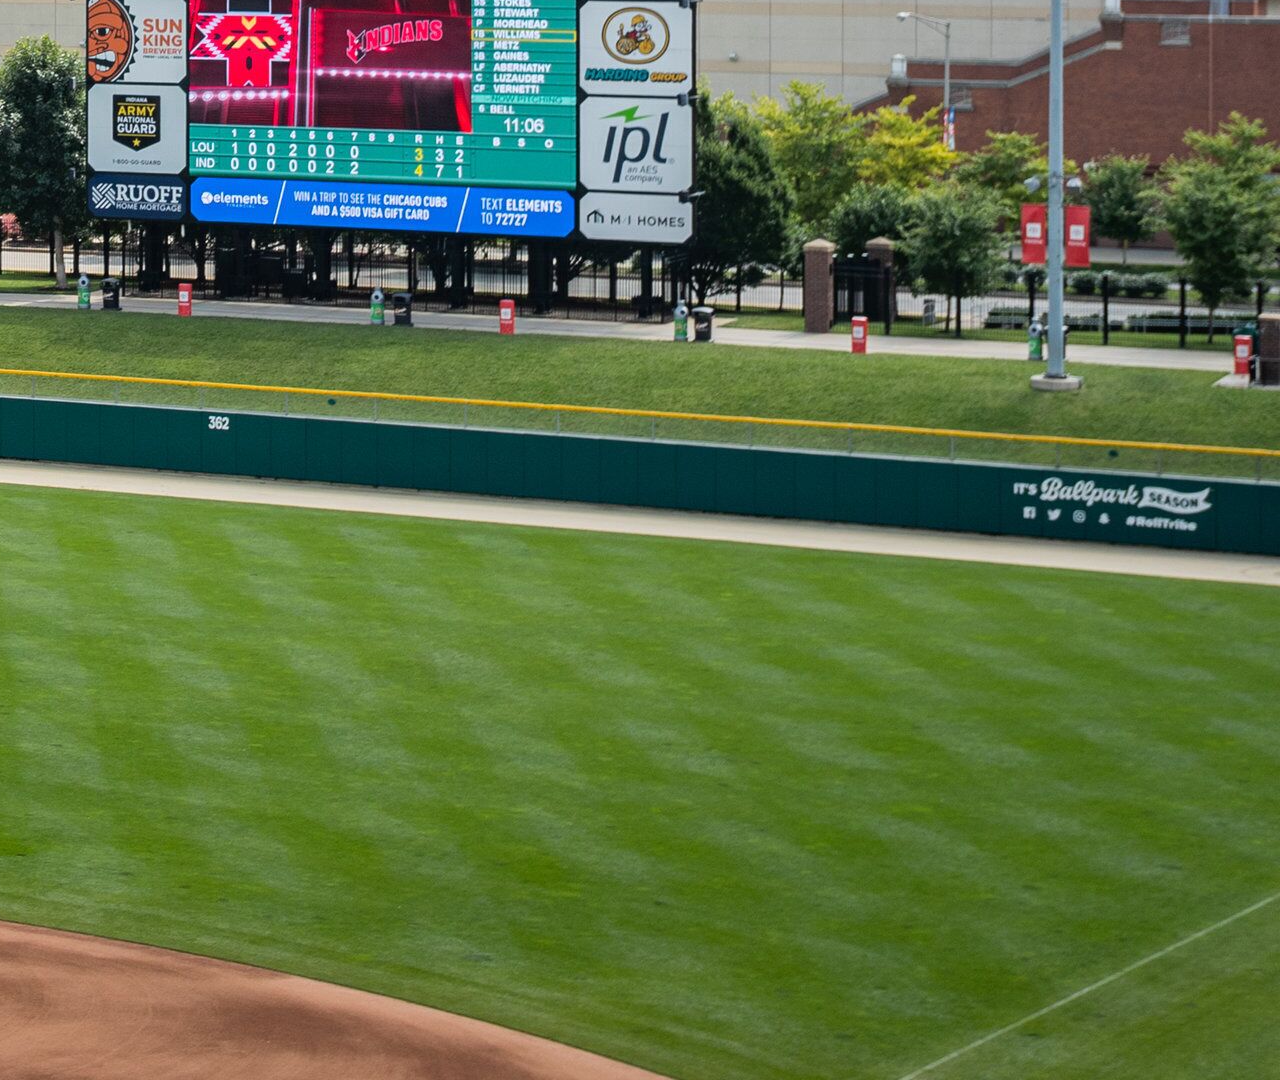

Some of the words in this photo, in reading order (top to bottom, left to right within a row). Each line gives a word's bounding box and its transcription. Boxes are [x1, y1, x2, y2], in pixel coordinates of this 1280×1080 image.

[493, 8, 540, 18] STEWART
[143, 18, 183, 33] SUN
[476, 18, 483, 27] P
[493, 18, 548, 29] MOREHEAD
[493, 29, 541, 39] WILLIAMS
[143, 34, 183, 47] KING
[473, 41, 486, 50] RF
[493, 41, 520, 50] METZ
[143, 47, 183, 55] BREWERY
[493, 51, 530, 61] GAINES
[473, 62, 486, 72] LF
[493, 62, 552, 73] ABERNATHY
[493, 73, 545, 83] LUZAUDER
[584, 68, 649, 81] HARDING
[650, 71, 688, 82] GROUP
[493, 84, 540, 94] VERNETTI
[118, 106, 156, 116] ARMY
[489, 104, 515, 114] BELL
[116, 116, 156, 124] NATIONAL
[503, 117, 545, 133] 11:06
[116, 123, 157, 134] GUARD
[232, 128, 238, 137] 1
[248, 129, 256, 138] 2
[267, 129, 274, 139] 3
[290, 130, 297, 139] 4
[308, 131, 316, 140] 5
[326, 131, 334, 141] 6
[351, 132, 358, 141] 7
[368, 132, 376, 142] 8
[387, 133, 395, 143] 9
[414, 134, 423, 144] R
[435, 135, 444, 145] H
[455, 136, 464, 146] E
[191, 142, 215, 153] LOU
[231, 142, 238, 155] 1
[248, 142, 257, 155] 0
[266, 143, 275, 156] 0
[289, 144, 298, 157] 2
[307, 144, 317, 157] 0
[325, 145, 335, 158] 0
[350, 145, 359, 159] 0
[414, 147, 424, 161] 3
[435, 148, 444, 162] 3
[455, 149, 464, 163] 2
[195, 157, 215, 169] IND
[230, 157, 239, 170] 0
[248, 158, 257, 171] 0
[266, 158, 275, 171] 0
[289, 159, 297, 172] 0
[307, 160, 316, 173] 0
[325, 160, 335, 174] 2
[350, 161, 359, 175] 2
[414, 164, 423, 178] 4
[435, 164, 444, 178] 7
[455, 165, 462, 179] 1
[640, 166, 658, 175] AES
[624, 173, 663, 185] company
[115, 183, 183, 203] RUOFF
[213, 191, 269, 205] elements
[293, 191, 310, 202] WIN
[311, 191, 318, 202] A
[319, 191, 337, 203] TRIP
[339, 192, 349, 203] TO
[350, 192, 365, 204] SEE
[367, 193, 381, 205] THE
[383, 194, 421, 207] CHICAGO
[423, 195, 448, 208] CUBS
[481, 197, 503, 211] TEXT
[505, 198, 562, 213] ELEMENTS
[115, 202, 138, 210] HOME
[139, 203, 182, 212] MORTGAGE
[311, 205, 330, 216] AND
[331, 205, 338, 216] A
[339, 205, 361, 218] $500
[362, 206, 383, 218] VISA
[385, 207, 404, 219] GIFT
[405, 208, 429, 221] CARD
[481, 212, 493, 225] TO
[495, 213, 528, 226] 72727
[637, 216, 685, 228] HOMES
[208, 415, 230, 430] 362
[1013, 482, 1038, 496] IT'S
[1040, 476, 1140, 507] Ballpark
[1147, 491, 1199, 508] SEASON
